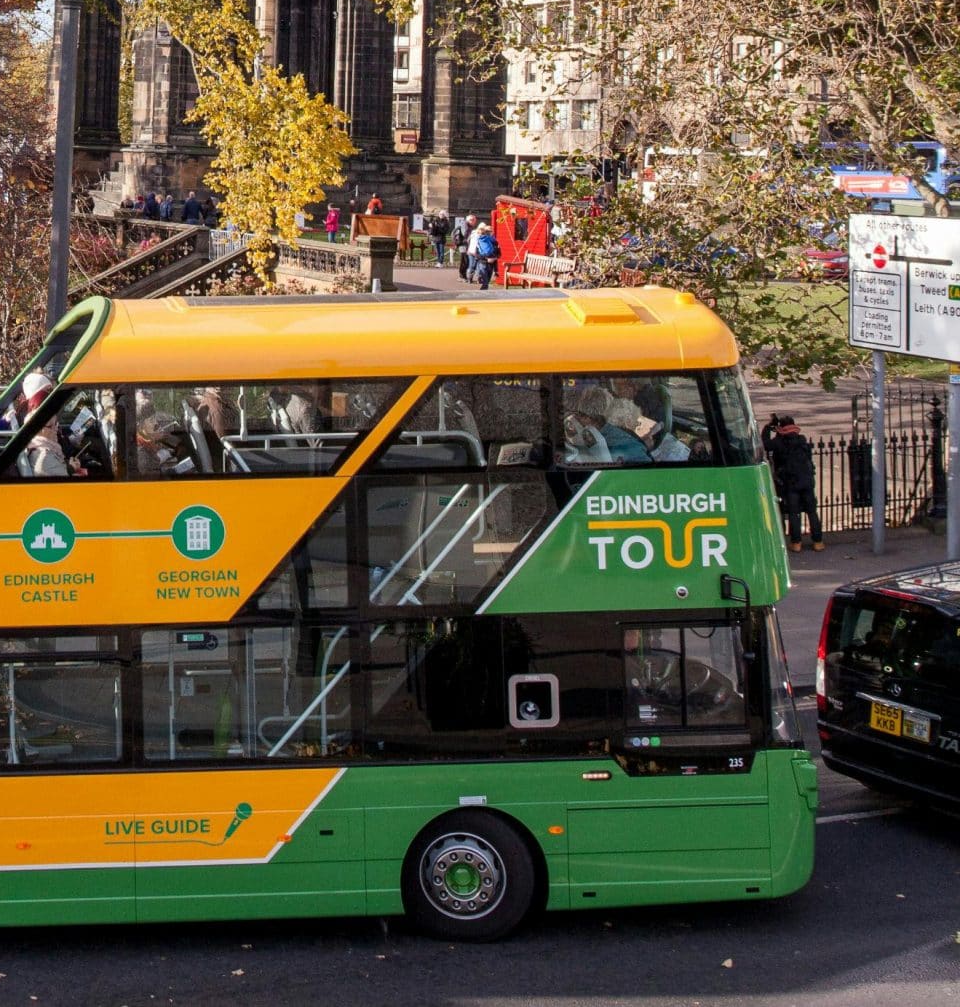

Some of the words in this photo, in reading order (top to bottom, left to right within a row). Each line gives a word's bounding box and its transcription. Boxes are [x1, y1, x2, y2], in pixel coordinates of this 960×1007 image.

[914, 267, 947, 280] Berwick
[920, 284, 947, 297] Tweed
[863, 295, 869, 303] &
[869, 296, 890, 306] cycles
[914, 302, 935, 314] Leith
[864, 310, 888, 323] Loading
[861, 321, 892, 332] permitted
[586, 492, 726, 516] EDINBURGH
[588, 526, 729, 570] TOUR
[3, 572, 96, 586] EDINBURGH
[158, 569, 239, 583] GEORGIAN
[21, 590, 79, 603] CASTLE
[156, 587, 191, 600] NEW
[195, 586, 241, 599] TOWN
[874, 702, 899, 720] SE65
[876, 716, 897, 732] KKB
[938, 735, 960, 753] TA
[728, 757, 745, 768] 235
[105, 820, 145, 836] LIVE
[150, 818, 212, 834] GUIDE
